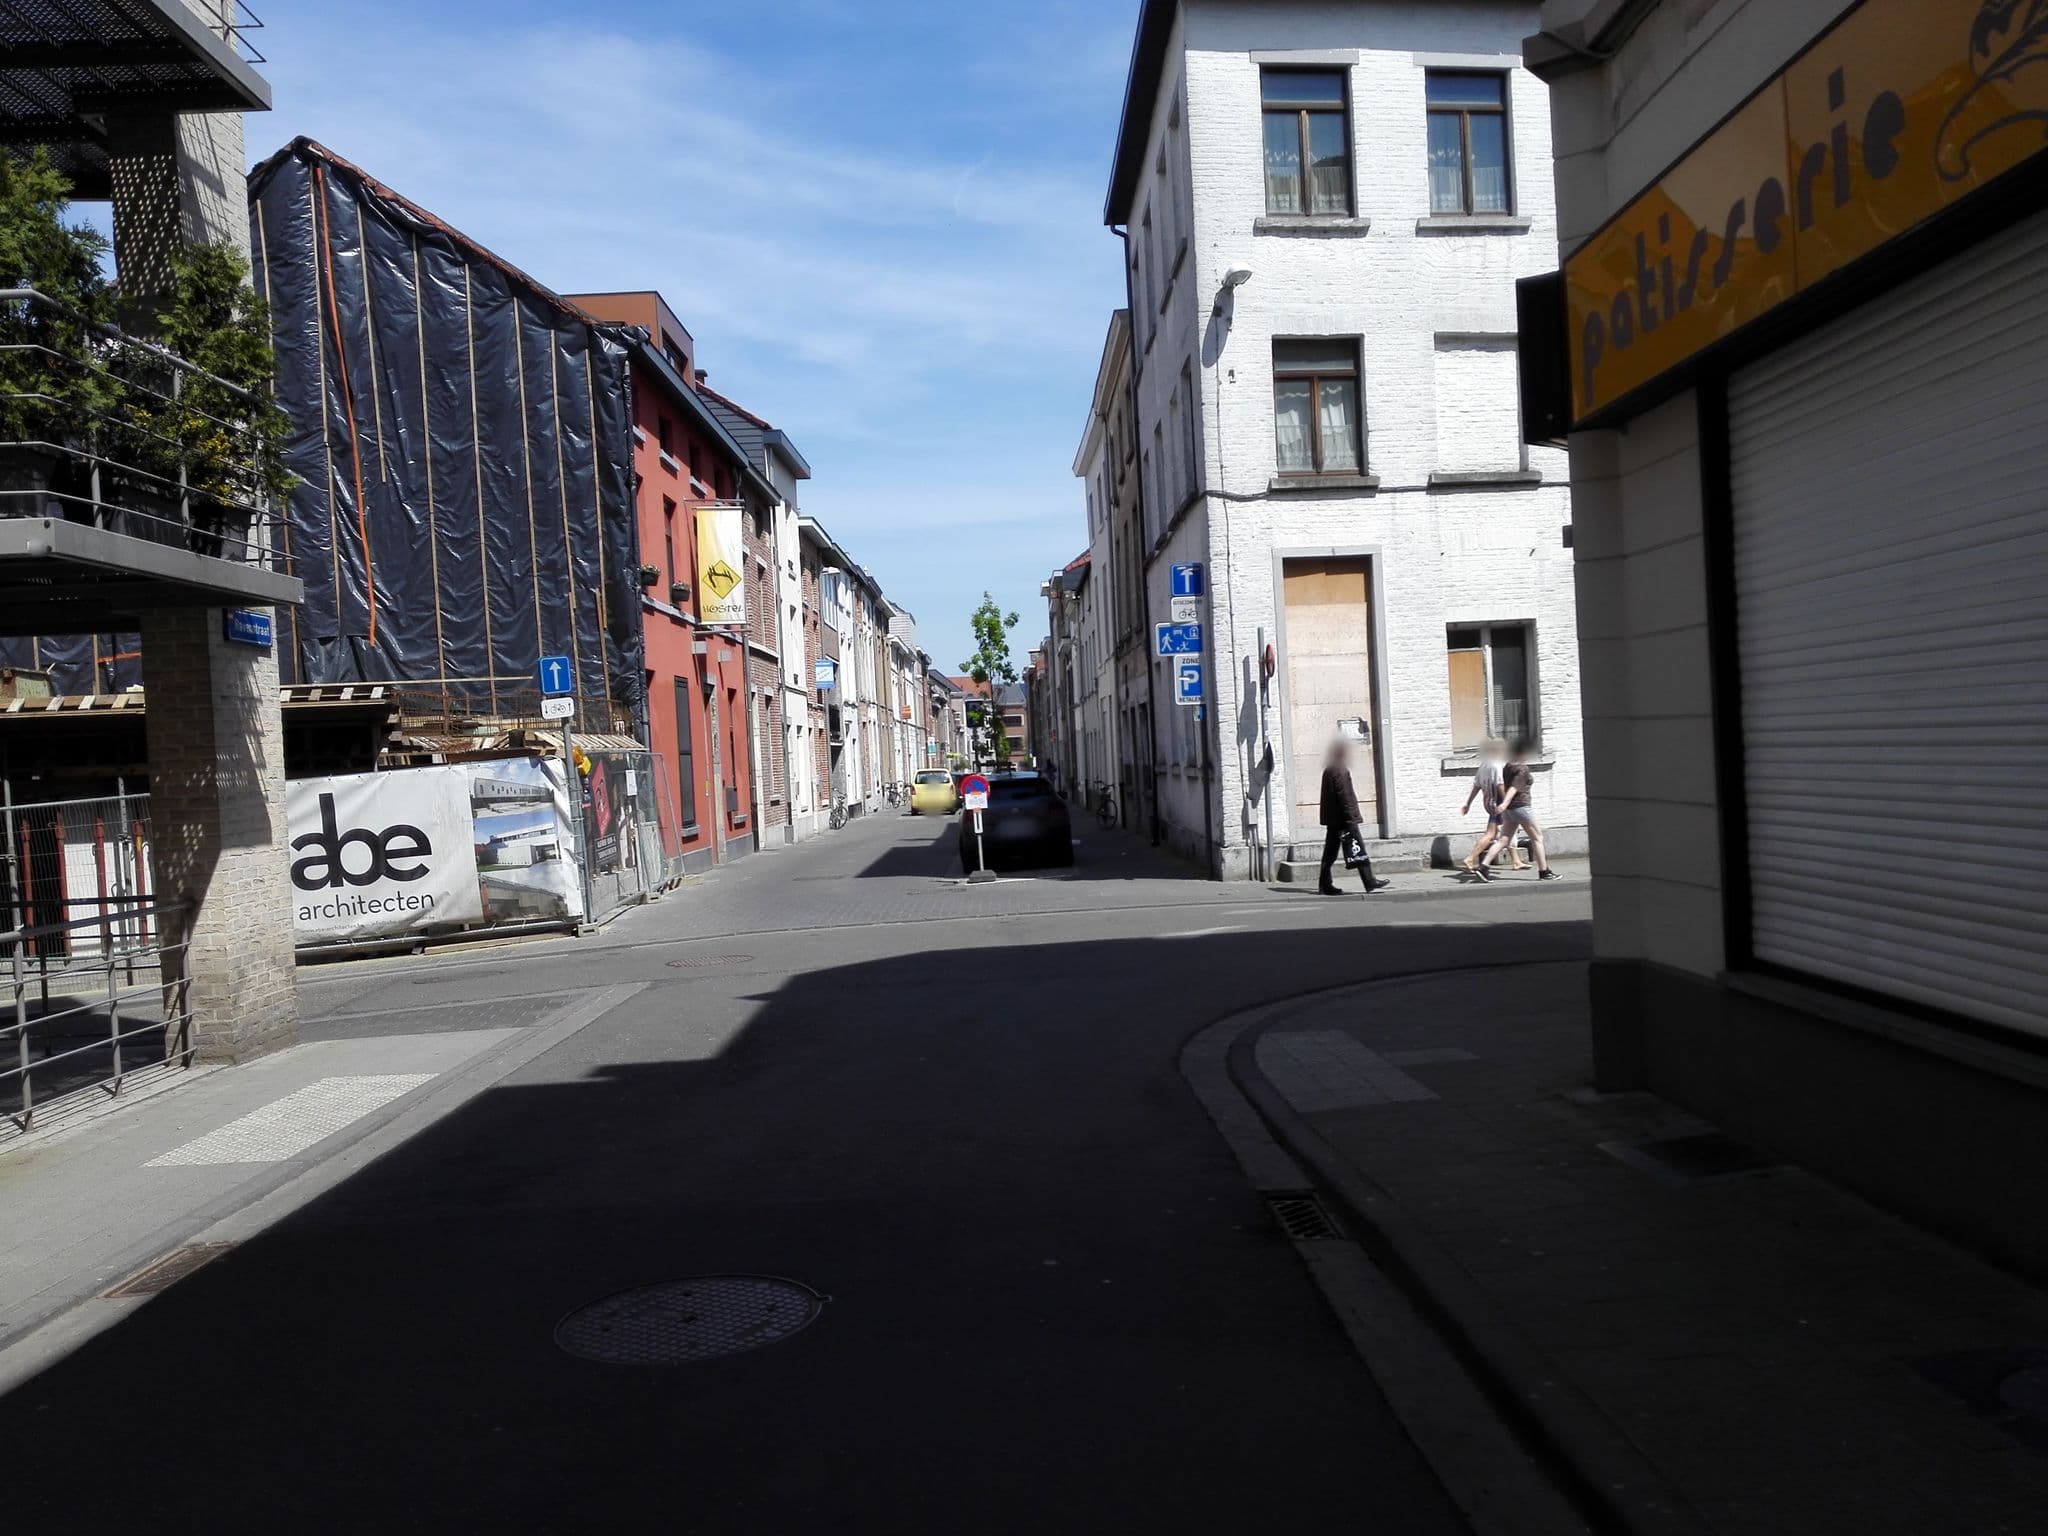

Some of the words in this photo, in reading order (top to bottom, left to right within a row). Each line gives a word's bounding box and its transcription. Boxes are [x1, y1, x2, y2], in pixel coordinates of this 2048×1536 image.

[1583, 65, 1906, 409] patisserie
[1182, 669, 1200, 691] P
[290, 792, 433, 891] abe
[298, 890, 435, 921] architecten
